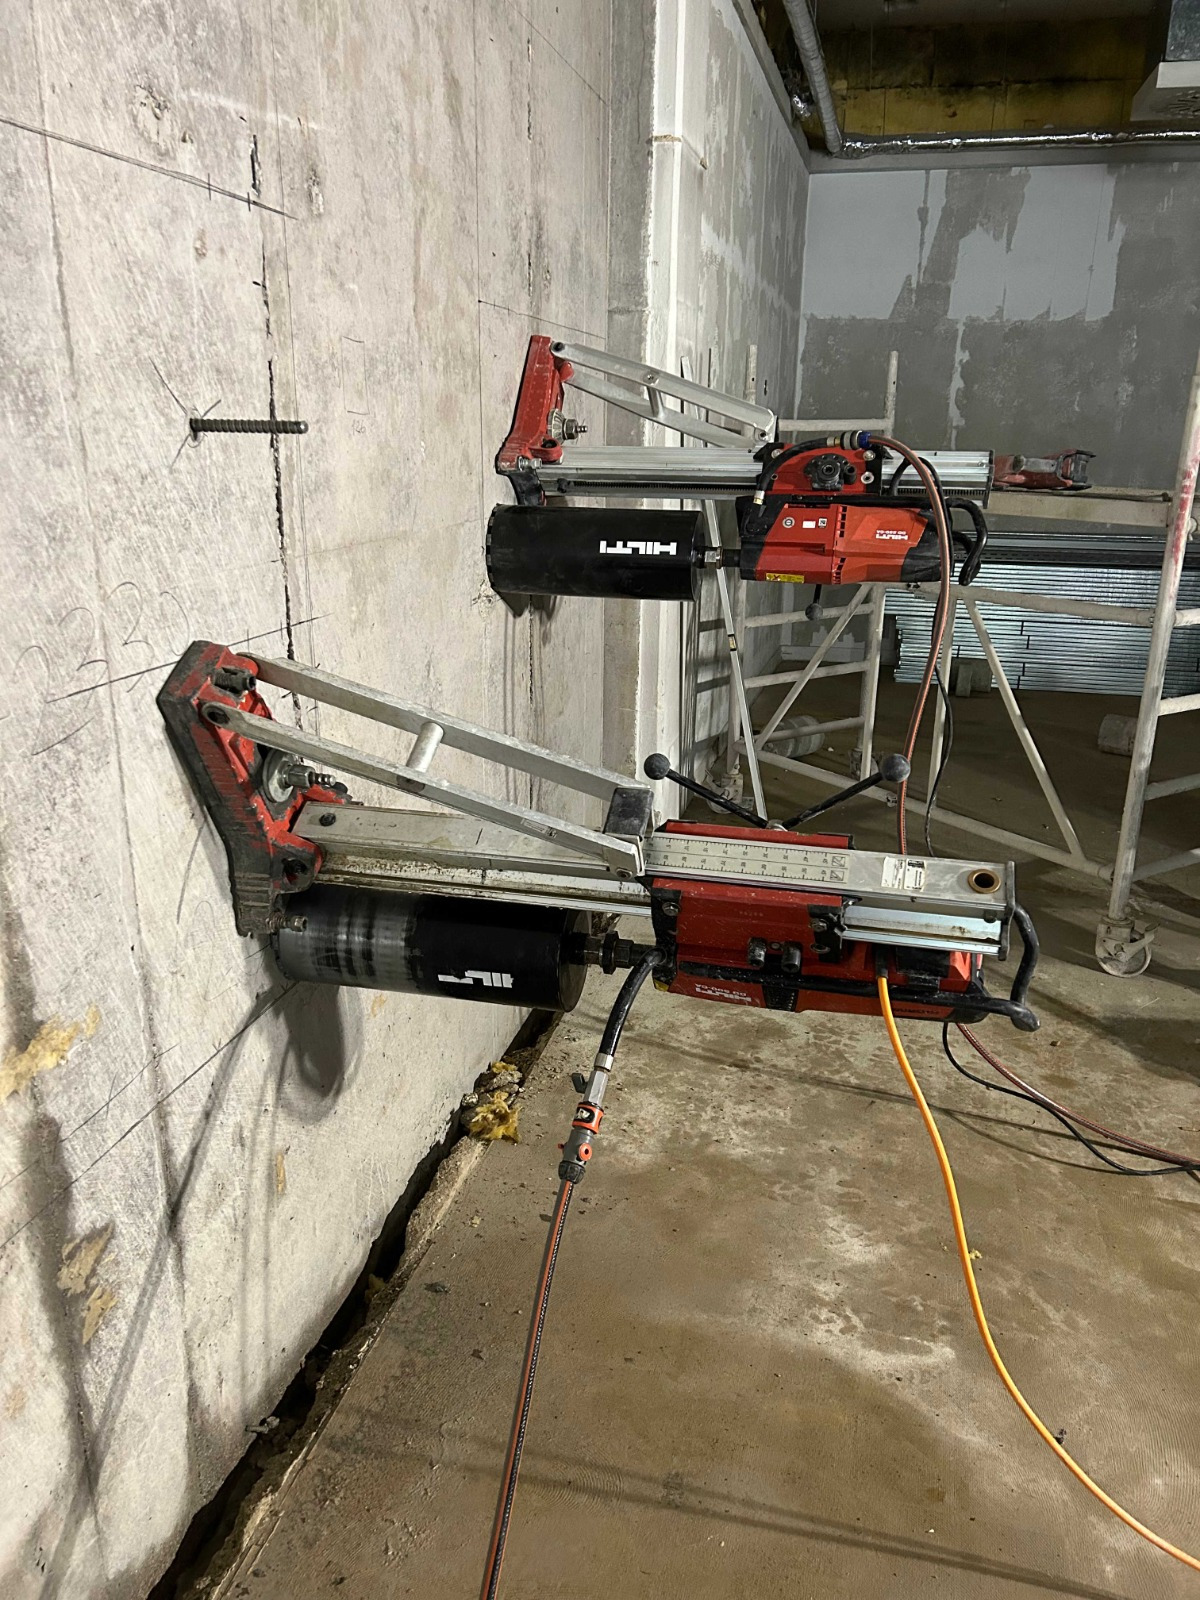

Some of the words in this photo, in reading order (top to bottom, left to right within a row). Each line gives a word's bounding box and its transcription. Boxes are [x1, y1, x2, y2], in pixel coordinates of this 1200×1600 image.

[875, 533, 909, 541] HILTI
[599, 540, 677, 556] HILTI
[694, 986, 752, 1002] HILTI
